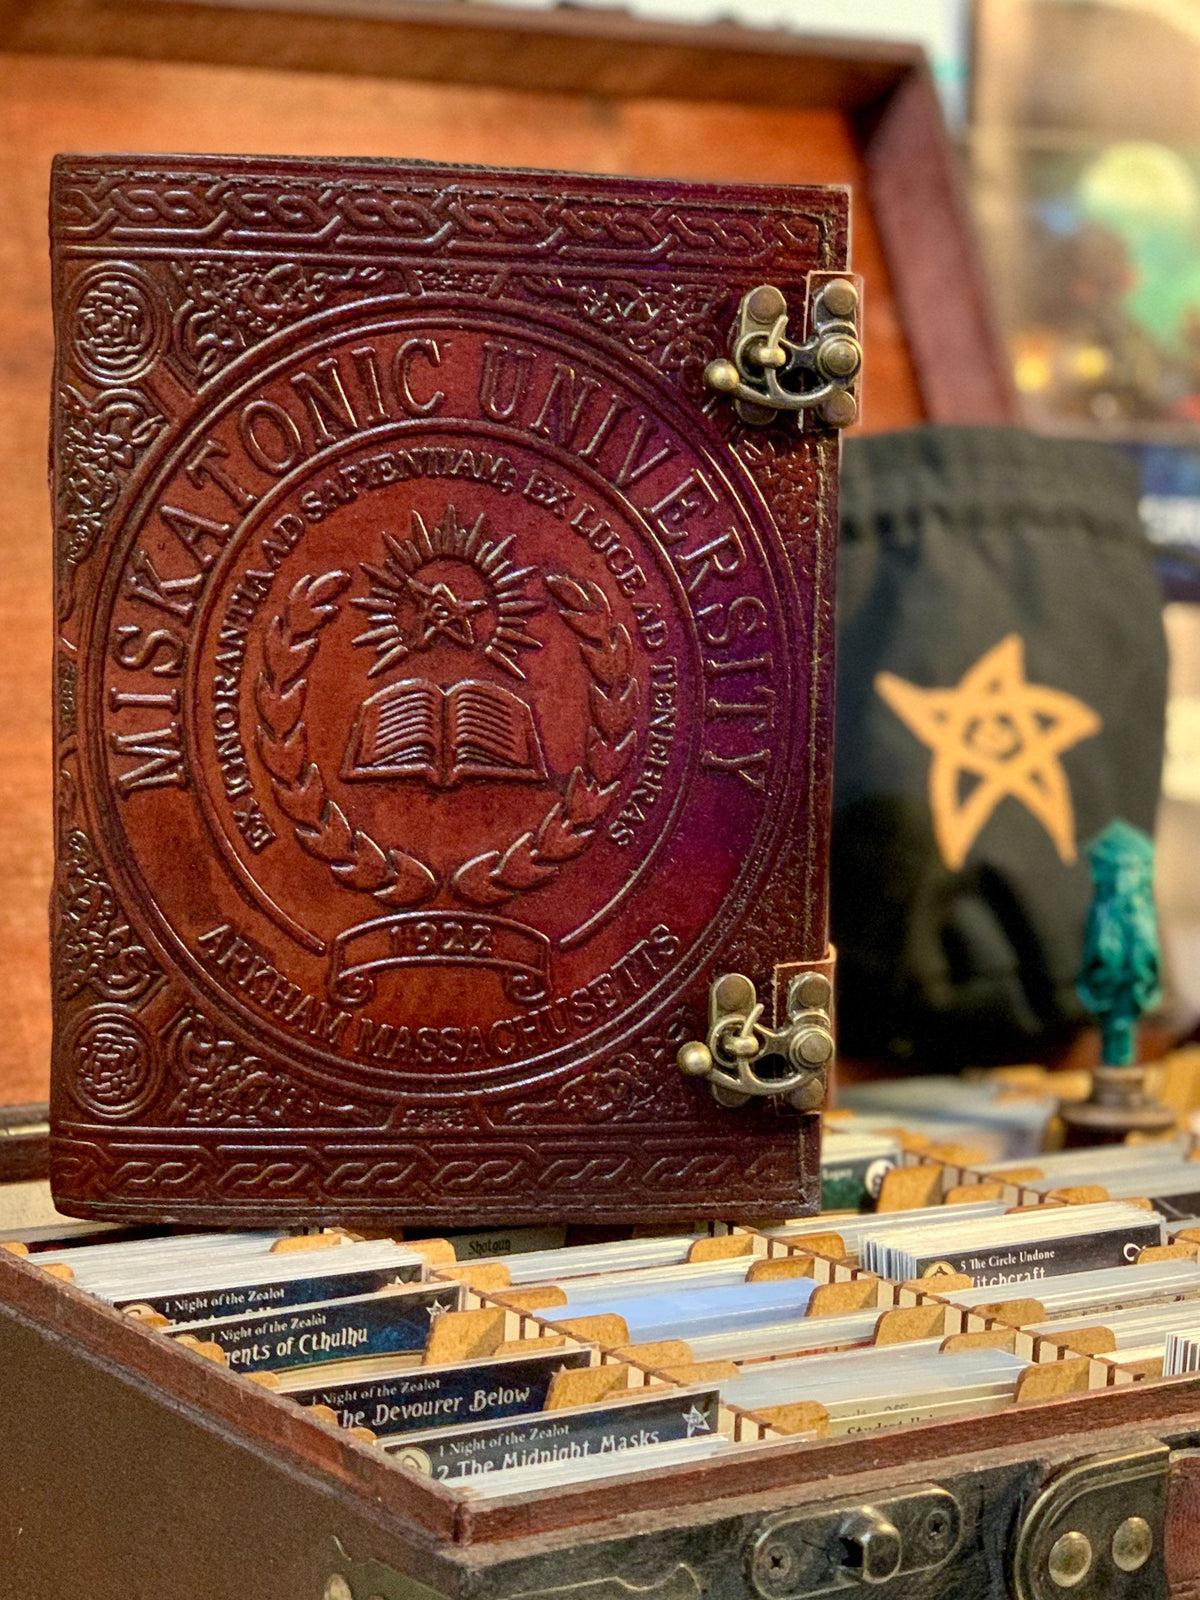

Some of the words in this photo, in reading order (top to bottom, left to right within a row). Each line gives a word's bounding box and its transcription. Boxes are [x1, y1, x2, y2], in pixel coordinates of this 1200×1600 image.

[108, 337, 446, 797] MISKATONIC
[480, 341, 775, 796] UNIVERSITY
[233, 797, 277, 851] EX
[262, 513, 305, 568] AD
[523, 470, 576, 516] EX
[570, 503, 648, 597] LUCE
[631, 602, 668, 647] AD
[390, 921, 492, 952] 1922
[198, 924, 353, 1044] ARKHAM
[353, 923, 681, 1063] MASSACHUSETTS
[960, 1260, 966, 1272] 5
[969, 1258, 986, 1271] The
[988, 1252, 1017, 1267] Circle
[1020, 1248, 1055, 1263] Undone
[971, 1266, 1046, 1289] itchcraft
[165, 1301, 170, 1313] 1
[174, 1297, 208, 1314] Night
[210, 1293, 226, 1307] of
[226, 1291, 245, 1305] the
[247, 1287, 285, 1302] Zealot
[220, 1327, 252, 1343] Night
[254, 1322, 270, 1336] of
[269, 1320, 288, 1334] the
[290, 1313, 327, 1330] Zealot
[276, 1336, 296, 1357] of
[299, 1326, 368, 1356] Cthulhu
[322, 1389, 358, 1407] Night
[361, 1385, 377, 1400] of
[377, 1383, 397, 1397] the
[400, 1378, 441, 1394] Zealot
[371, 1394, 464, 1427] Devourer
[468, 1386, 531, 1413] Below
[437, 1464, 450, 1481] 2
[456, 1458, 495, 1478] The
[501, 1439, 591, 1470] Midnight
[599, 1429, 660, 1455] Masks
[438, 1444, 445, 1458] 1
[449, 1438, 486, 1457] Night
[488, 1432, 505, 1448] of
[504, 1431, 526, 1446] the
[529, 1424, 570, 1442] Zealot
